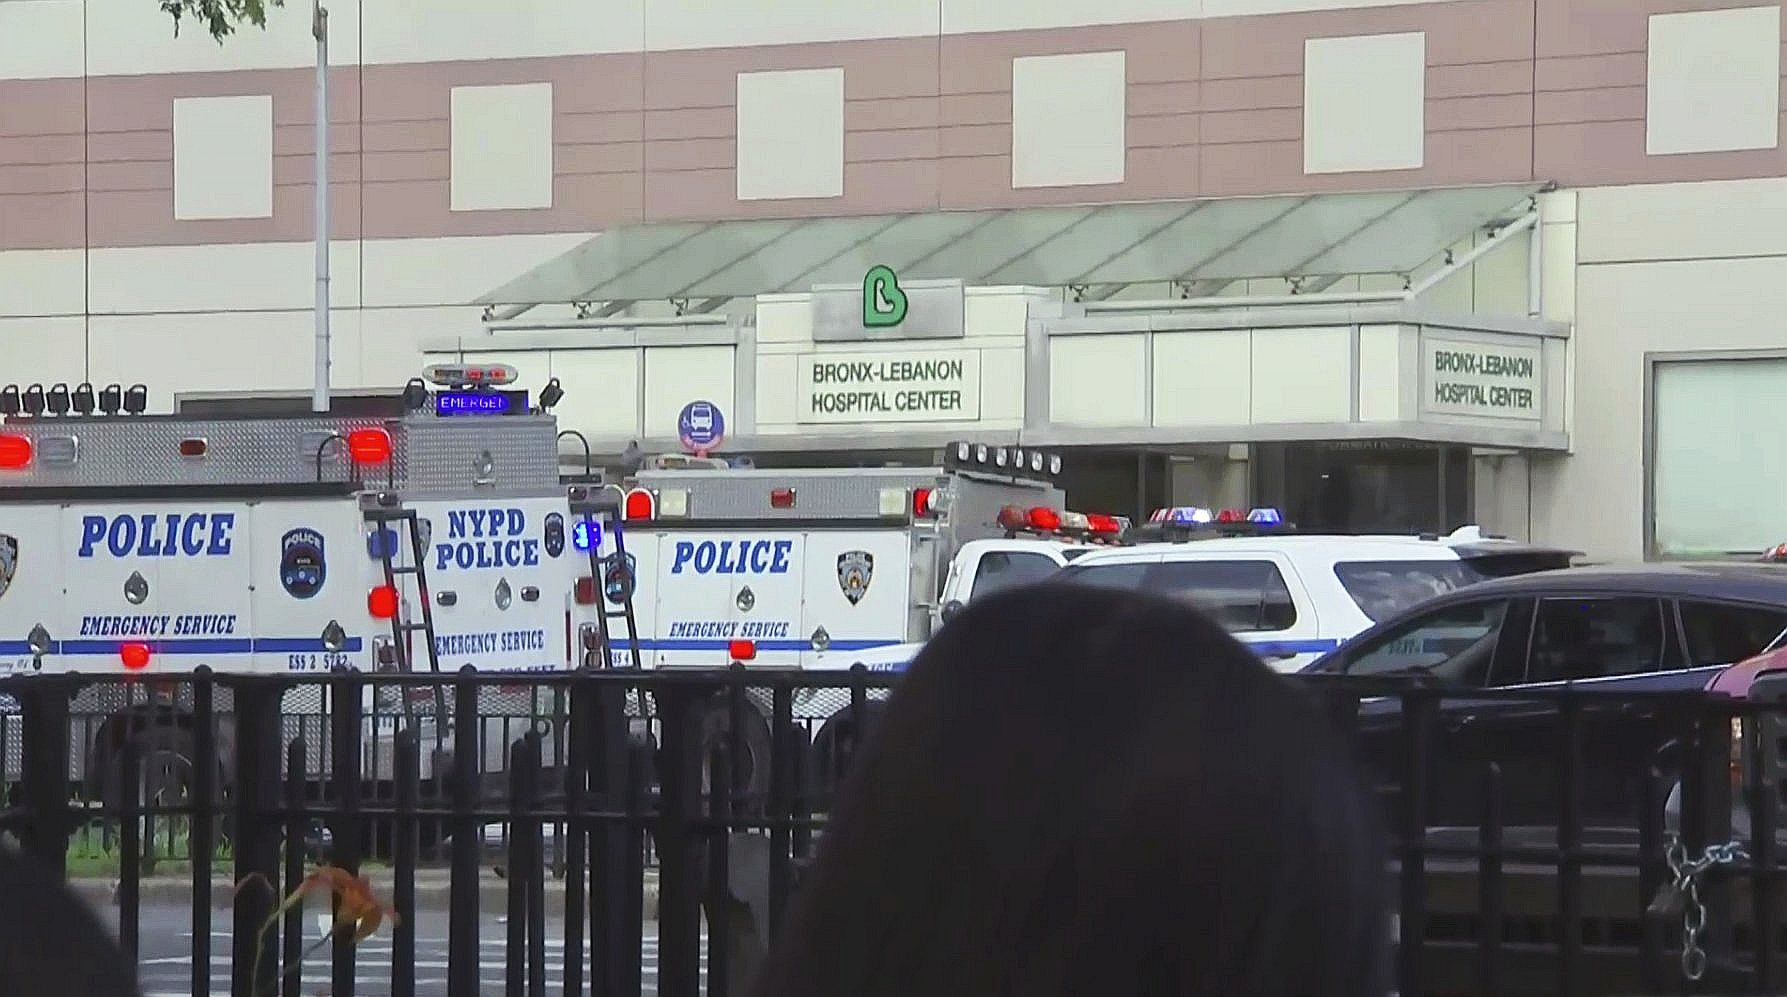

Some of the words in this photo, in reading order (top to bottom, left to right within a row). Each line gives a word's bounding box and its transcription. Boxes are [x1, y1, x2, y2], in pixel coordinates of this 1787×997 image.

[813, 360, 962, 384] BRONX-LEBANON
[1435, 351, 1532, 378] BRONX-LEBANON
[812, 392, 890, 412] HOSPITAL
[895, 390, 961, 411] CENTER
[1435, 381, 1487, 405] HOSPITAL
[1490, 386, 1532, 409] CENTER
[78, 513, 235, 557] POLICE
[448, 508, 525, 537] NYPD
[284, 531, 322, 550] POLICE
[436, 539, 539, 570] POLICE
[671, 540, 792, 574] POLICE
[80, 615, 170, 636] EMERGENCY
[174, 614, 236, 635] SERVICE
[669, 622, 739, 638] EMERGENCY
[740, 622, 789, 638] SERVICE
[435, 632, 497, 656] EMERGENCY
[501, 629, 544, 652] SERVICE
[289, 654, 305, 670] ESS
